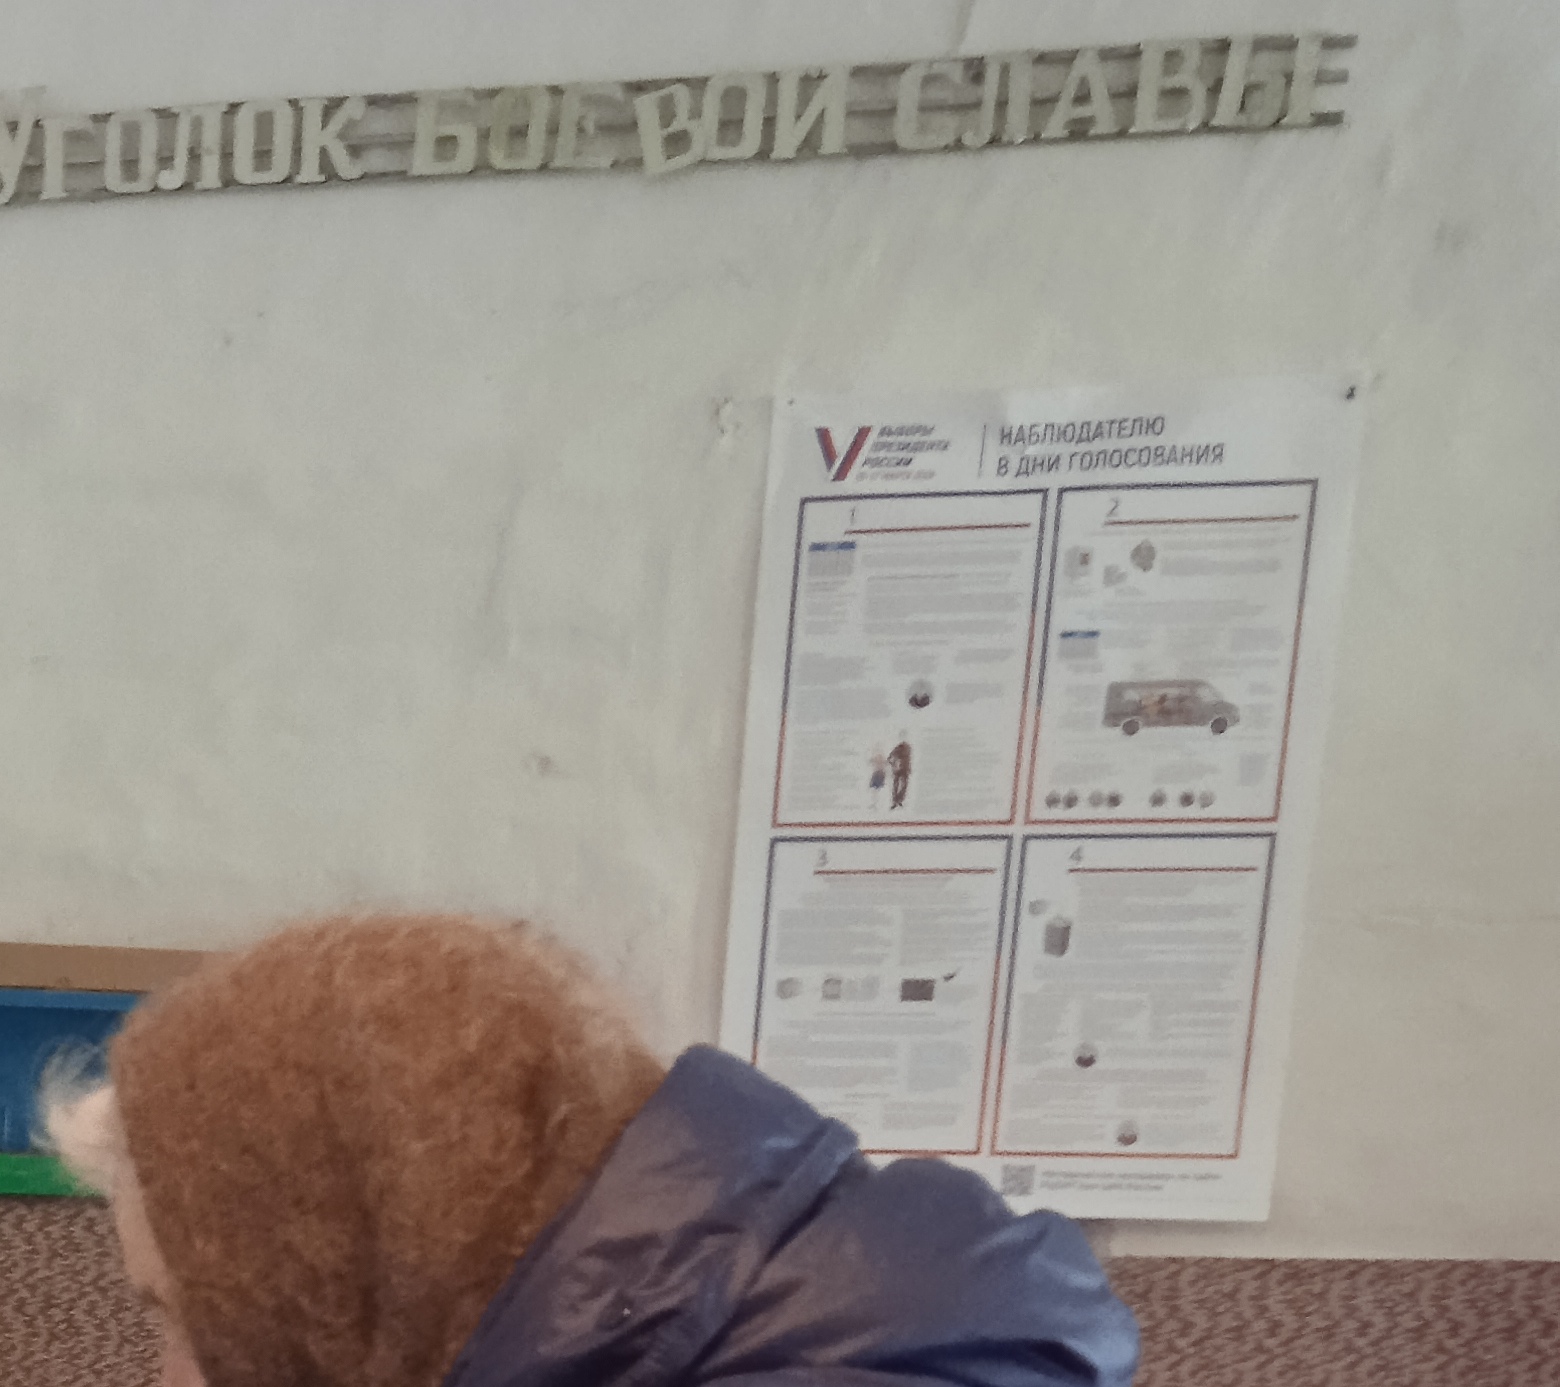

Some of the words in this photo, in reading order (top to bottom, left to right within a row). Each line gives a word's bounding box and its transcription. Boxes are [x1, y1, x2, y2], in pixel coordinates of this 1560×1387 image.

[892, 34, 1324, 149] СЛАВЫ
[1000, 416, 1166, 446] НАБЛЮДАТЕЛЮ
[996, 455, 1009, 477] В
[1014, 454, 1061, 478] ДНИ
[1068, 443, 1225, 472] ГОЛОСОВАНИЯ
[1104, 497, 1120, 518] 2
[1068, 845, 1083, 865] 4
